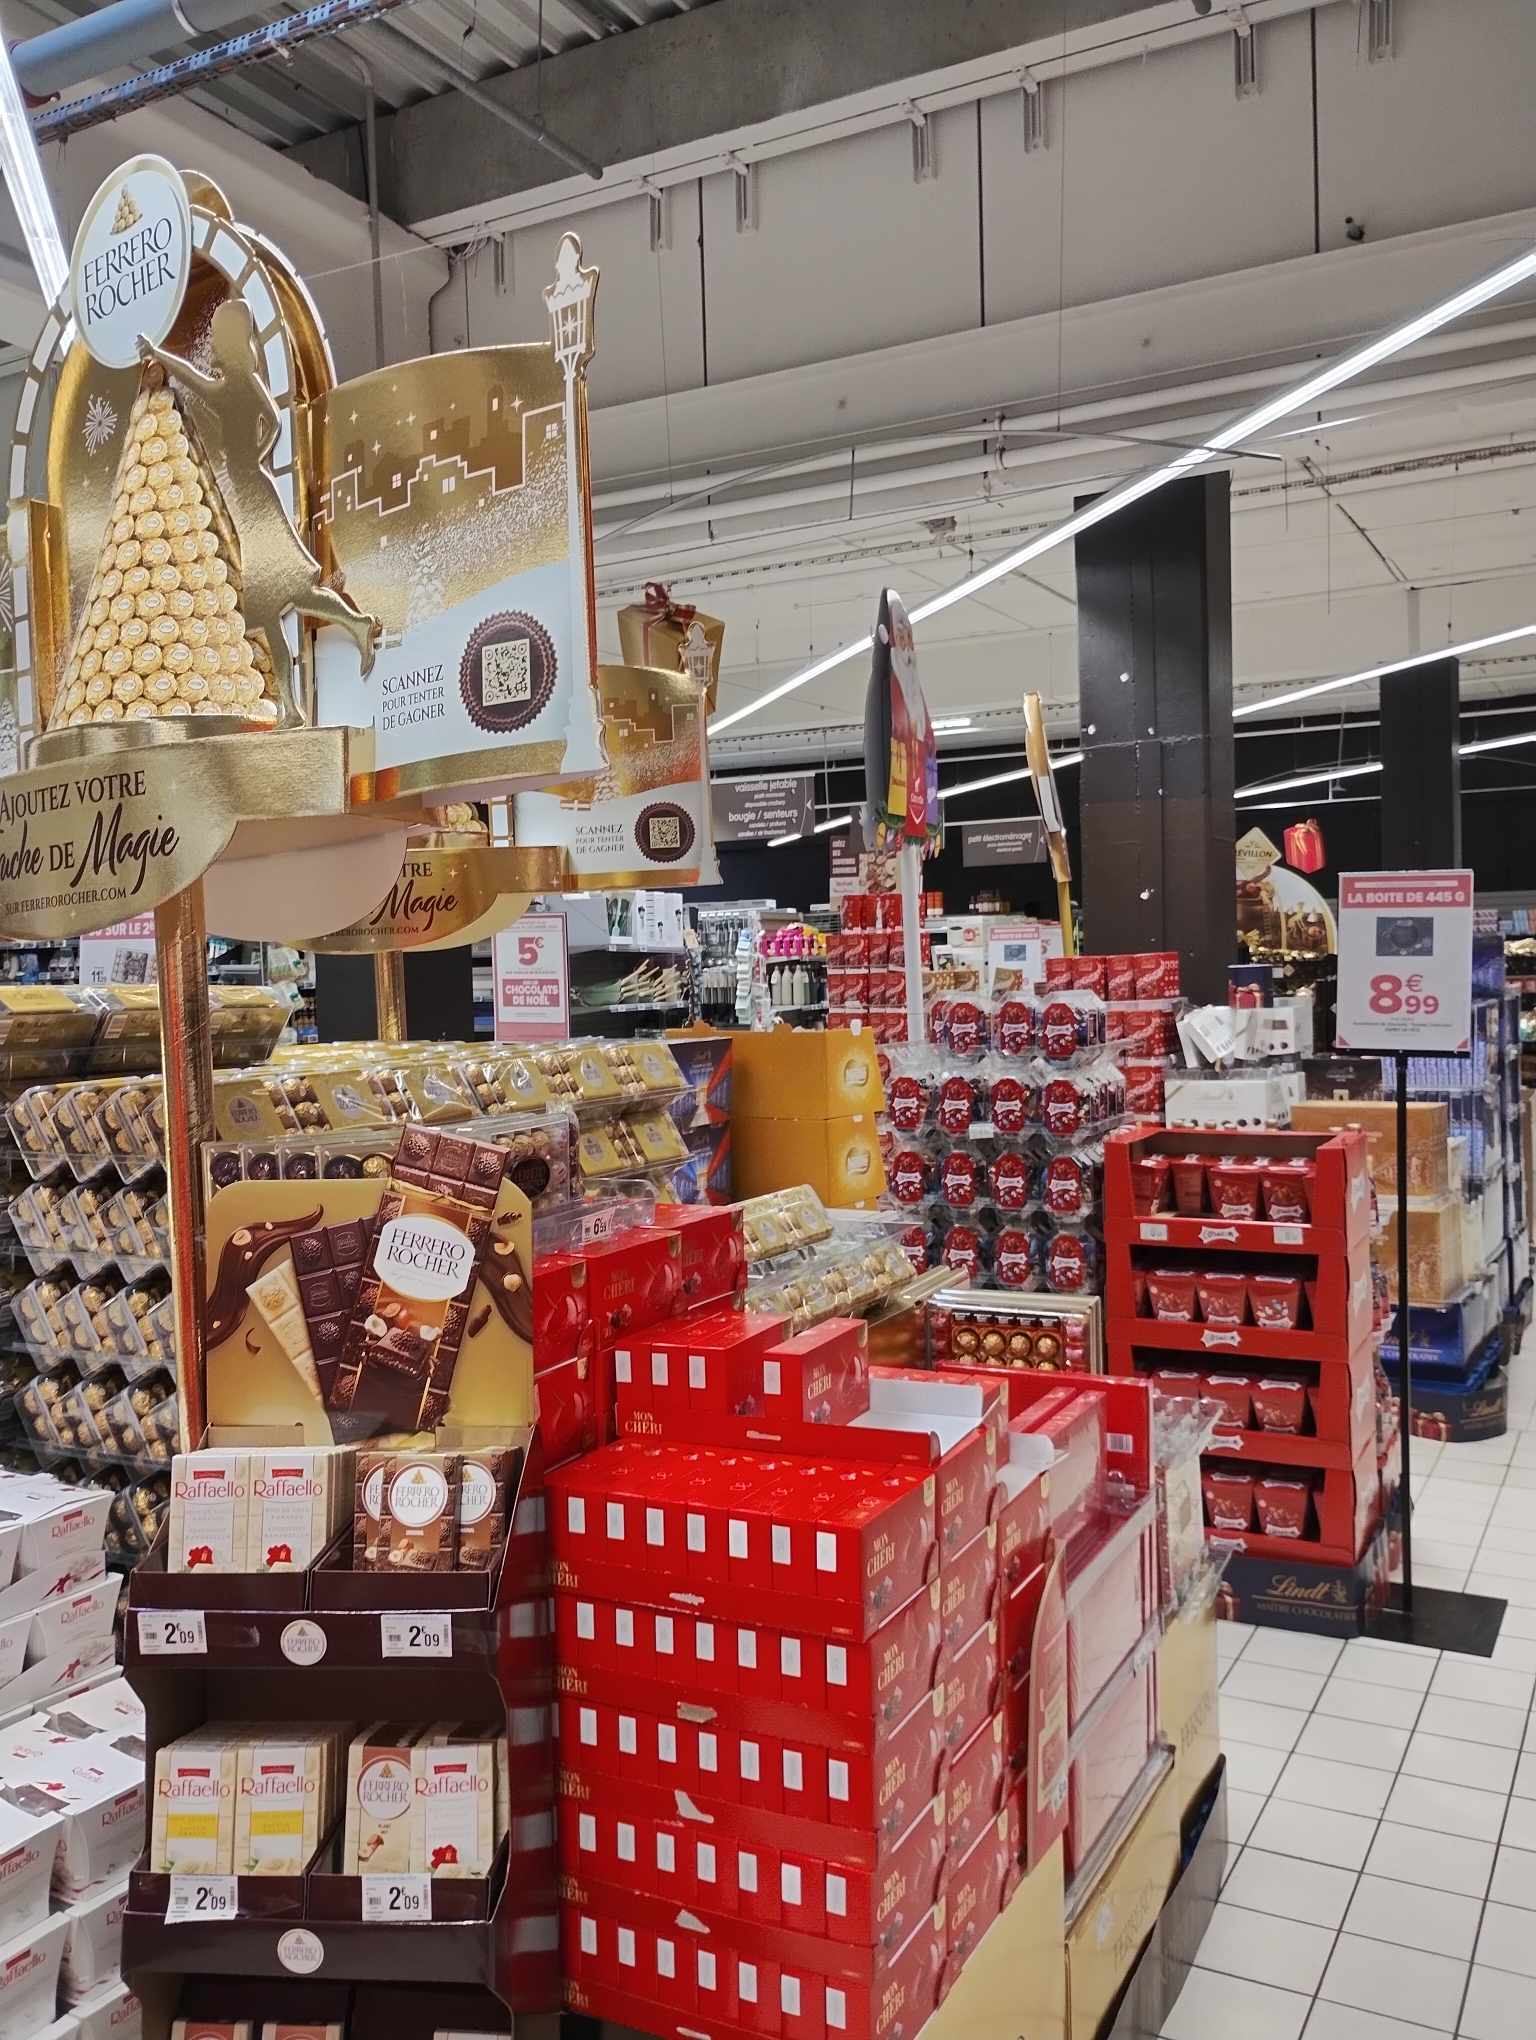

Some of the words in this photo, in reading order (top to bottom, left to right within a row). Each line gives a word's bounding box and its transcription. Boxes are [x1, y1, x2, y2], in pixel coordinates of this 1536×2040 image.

[84, 218, 172, 293] FERRERO
[86, 252, 176, 325] ROCHER
[382, 664, 444, 696] SCANNEZ
[382, 695, 407, 712] POUR
[408, 686, 444, 705] TENTER
[382, 714, 396, 731] DE
[397, 703, 446, 727] GAGNER
[0, 783, 71, 826] AJOUTEZ
[75, 770, 147, 804] VOTRE
[728, 811, 756, 823] bougie
[763, 809, 799, 820] senteurs
[576, 823, 624, 835] SCANNEZ
[49, 841, 76, 872] DE
[70, 802, 180, 895] Magie
[5, 902, 19, 916] SUR
[21, 887, 128, 914] FERREROROCHER.COM
[369, 879, 458, 932] Magie
[1347, 893, 1364, 904] LA
[1366, 892, 1404, 904] BOITE
[1404, 892, 1424, 903] DE
[1426, 891, 1452, 903] 445
[1455, 890, 1465, 902] G
[128, 922, 141, 936] LE
[504, 984, 559, 996] CHOCOLATS
[512, 995, 526, 1006] DE
[391, 1228, 466, 1261] FERRERO
[387, 1245, 460, 1280] ROCHER
[624, 1419, 663, 1435] CHERI
[632, 1410, 653, 1421] MON
[175, 1480, 246, 1500] Raffaello
[253, 1478, 324, 1499] Raffaello
[51, 1513, 96, 1539] Raffaello
[1265, 1574, 1331, 1600] Lindt
[158, 1778, 231, 1798] Raffaello
[241, 1776, 315, 1796] Raffaello
[415, 1775, 489, 1797] Raffaello
